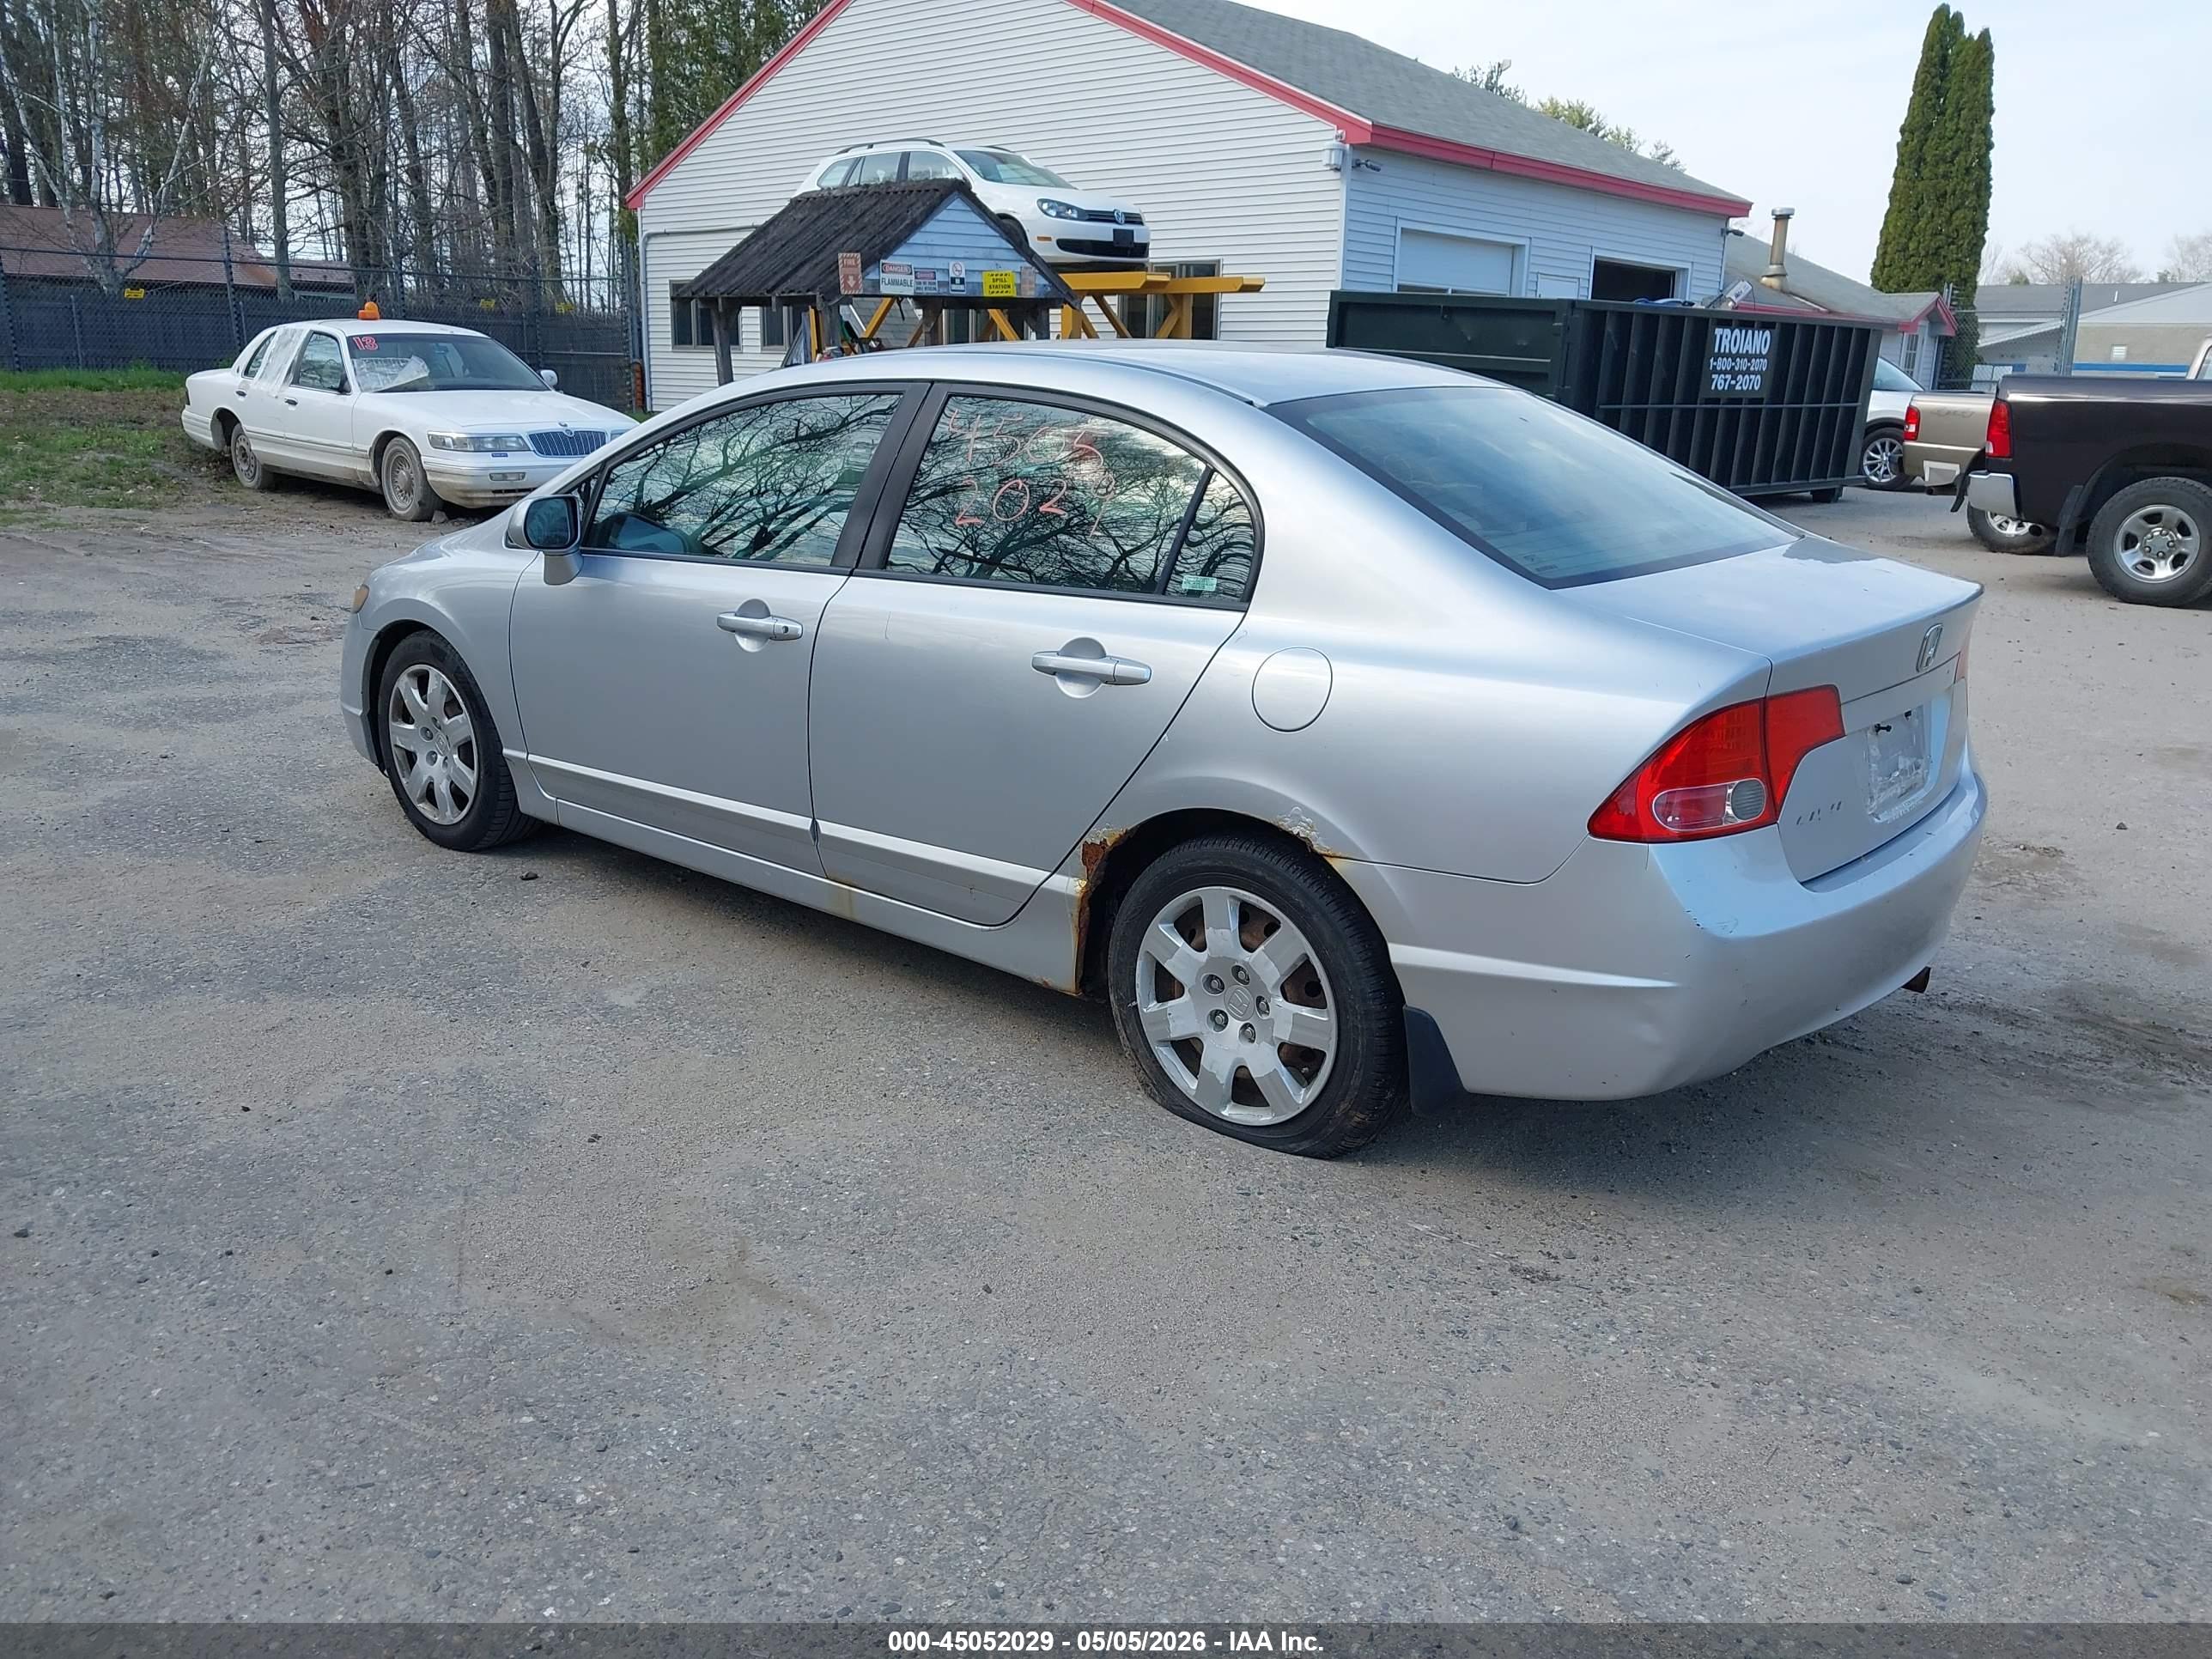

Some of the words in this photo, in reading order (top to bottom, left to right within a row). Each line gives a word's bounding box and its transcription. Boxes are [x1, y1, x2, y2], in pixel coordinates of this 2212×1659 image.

[881, 277, 914, 288] FLAMMABLE
[352, 336, 379, 351] 13
[1714, 328, 1771, 355] TROIANO
[1710, 357, 1767, 371] 1-800-310-2070
[1711, 374, 1761, 391] 767-2070
